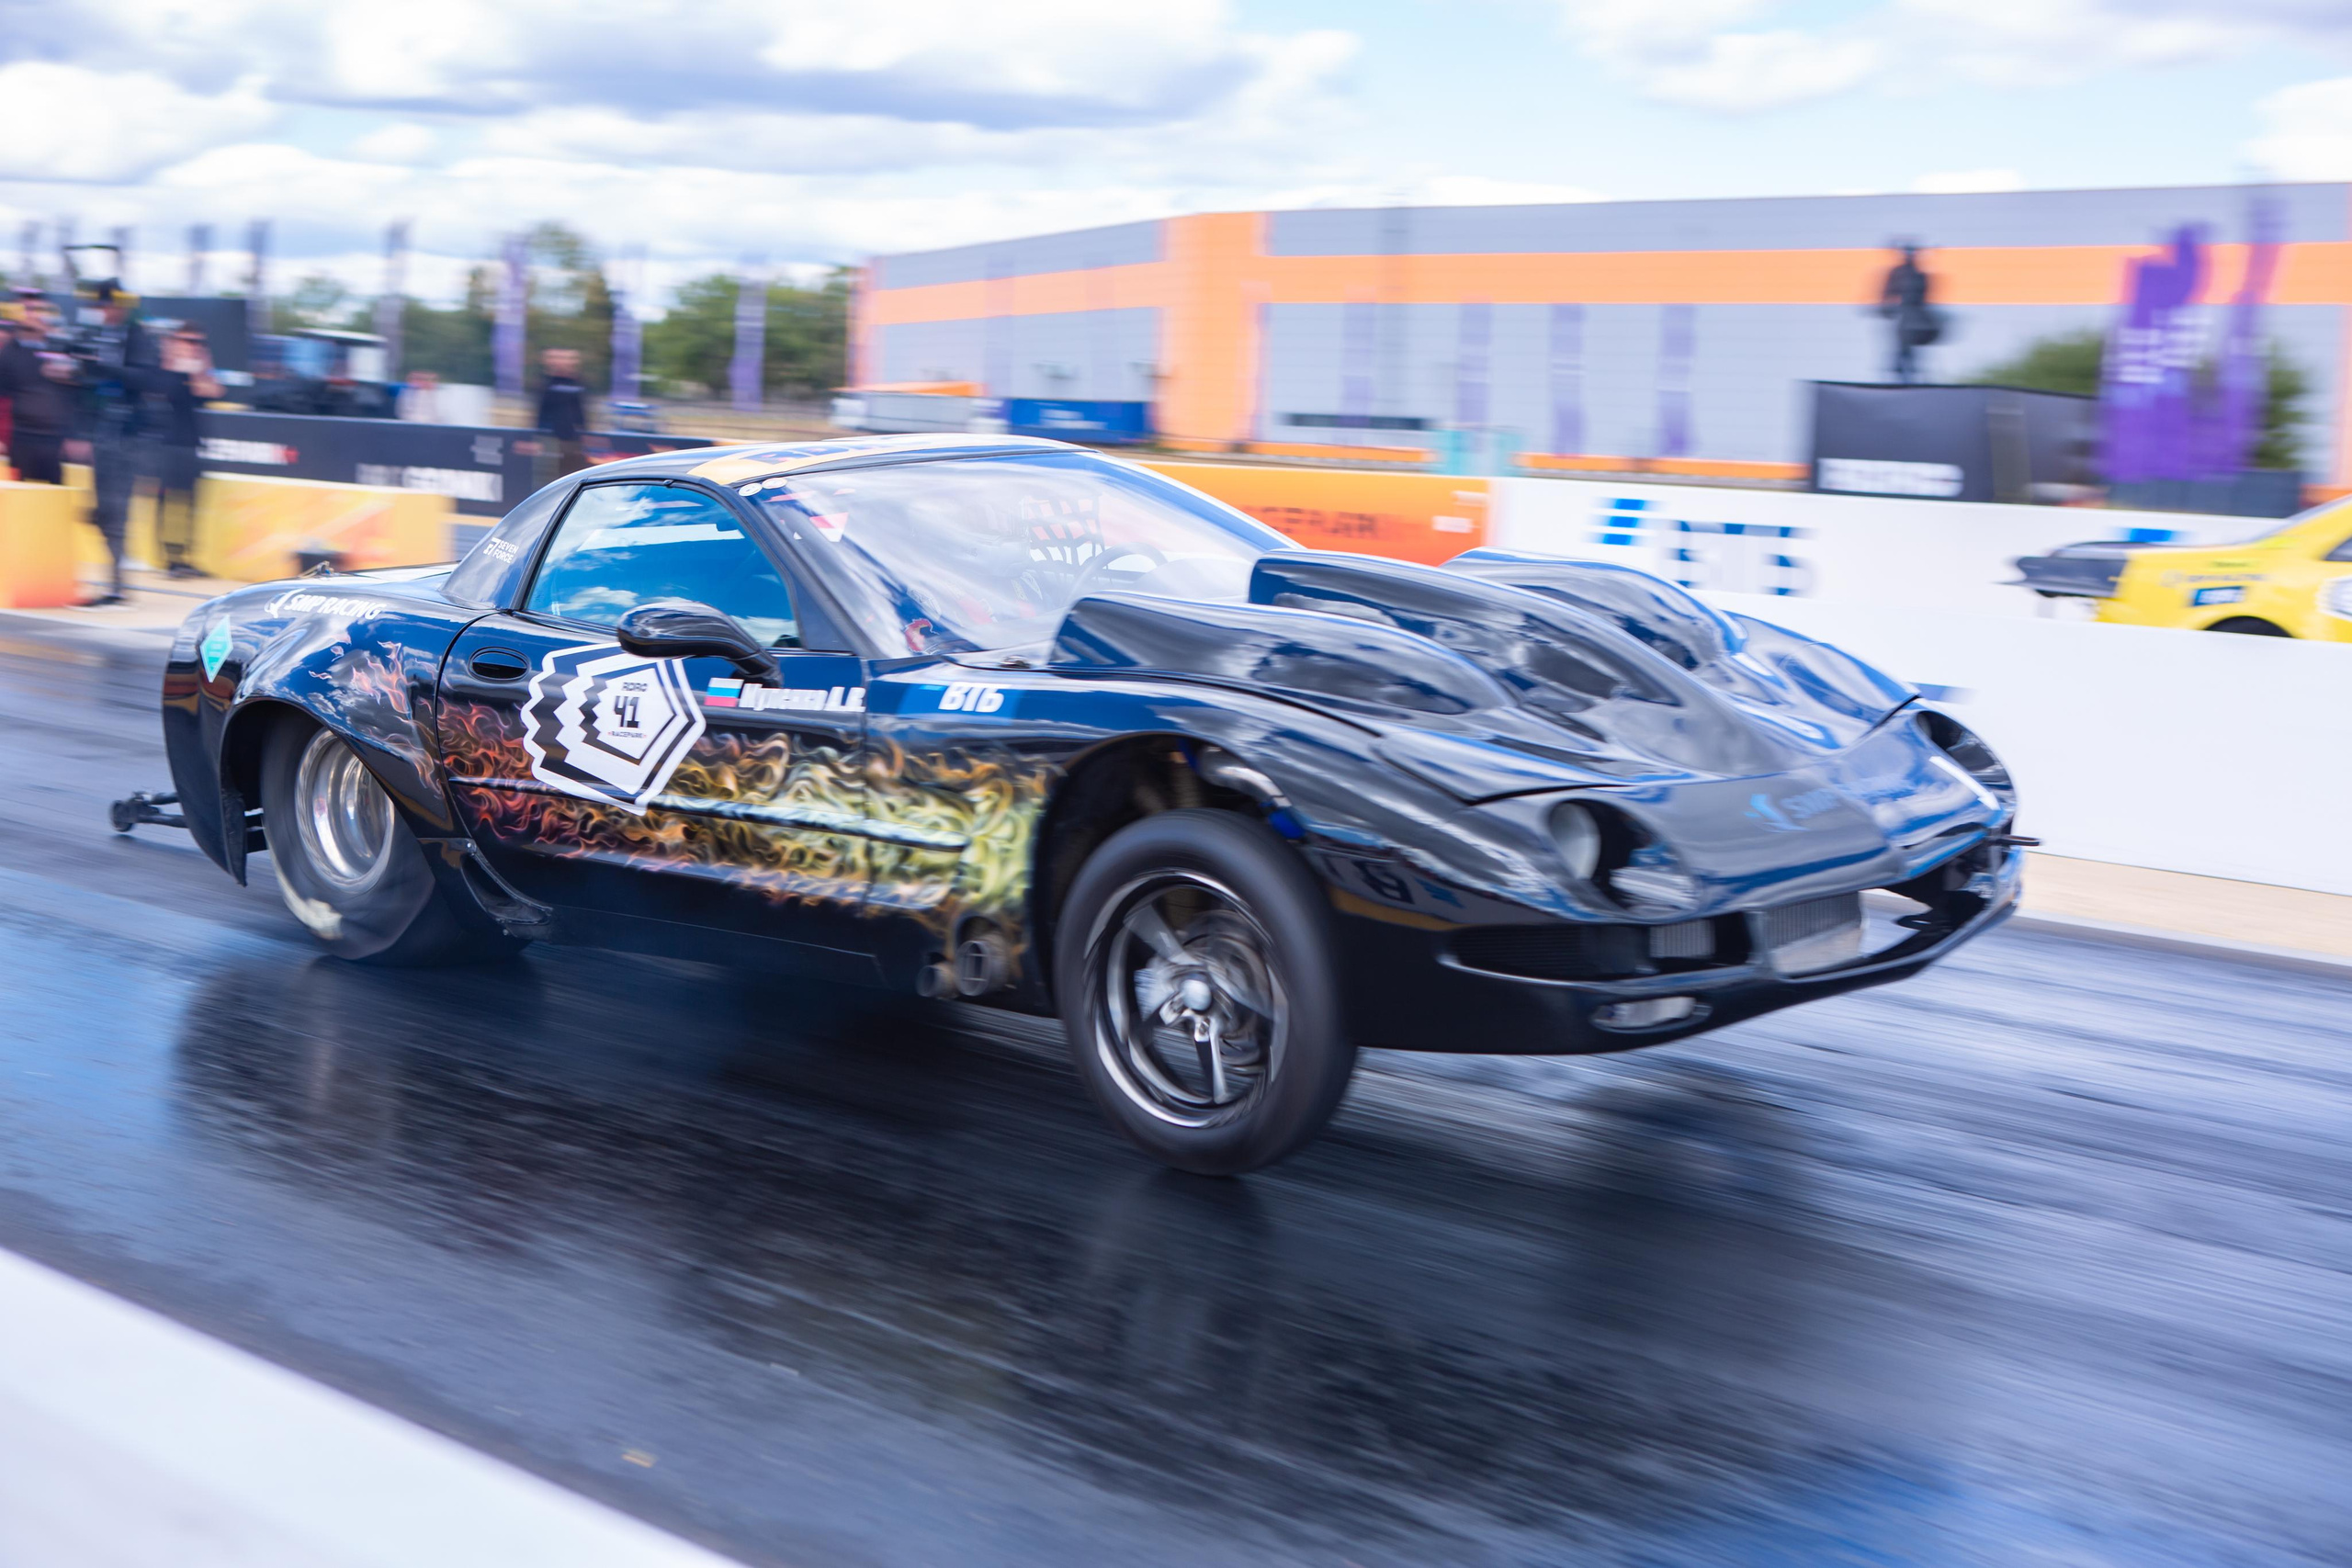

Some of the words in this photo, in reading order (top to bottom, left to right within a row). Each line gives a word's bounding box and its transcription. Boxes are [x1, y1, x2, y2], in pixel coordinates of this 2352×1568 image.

[492, 548, 514, 564] FORCE
[498, 539, 520, 555] SEVEN
[284, 593, 326, 613] SMP
[316, 597, 387, 620] RACING
[938, 681, 1007, 713] ВТБ
[614, 695, 640, 728] 41
